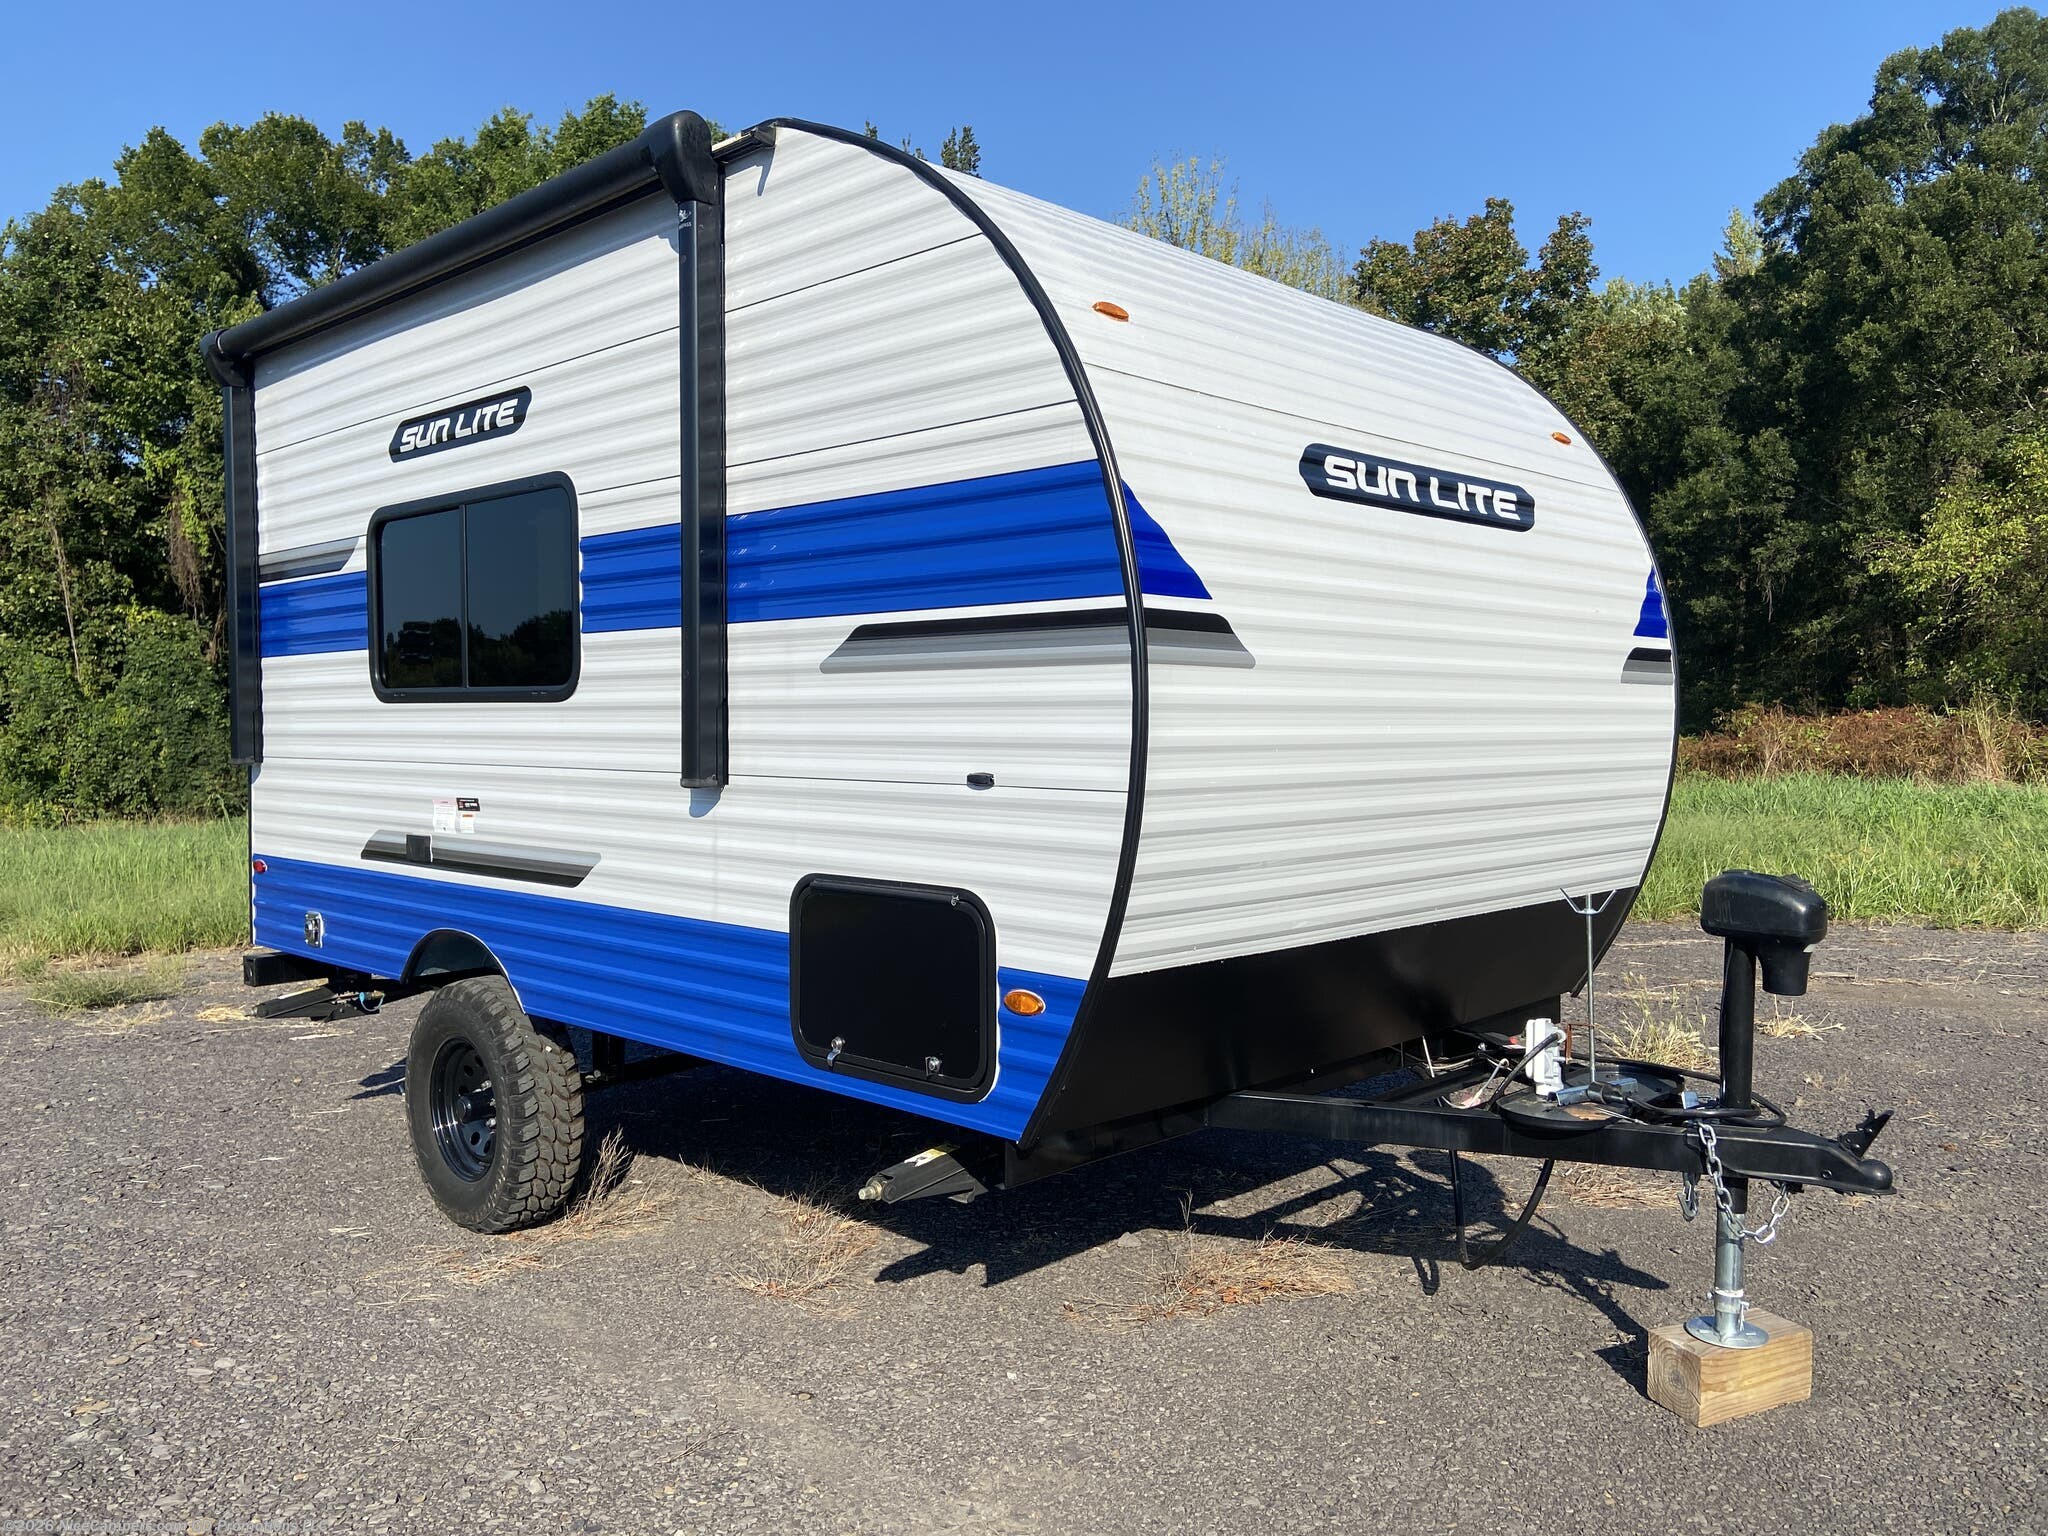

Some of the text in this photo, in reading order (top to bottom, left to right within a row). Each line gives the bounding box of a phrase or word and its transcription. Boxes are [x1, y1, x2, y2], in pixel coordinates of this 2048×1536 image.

[400, 398, 518, 453] SUN LITE
[1324, 454, 1521, 521] SUN LITE
